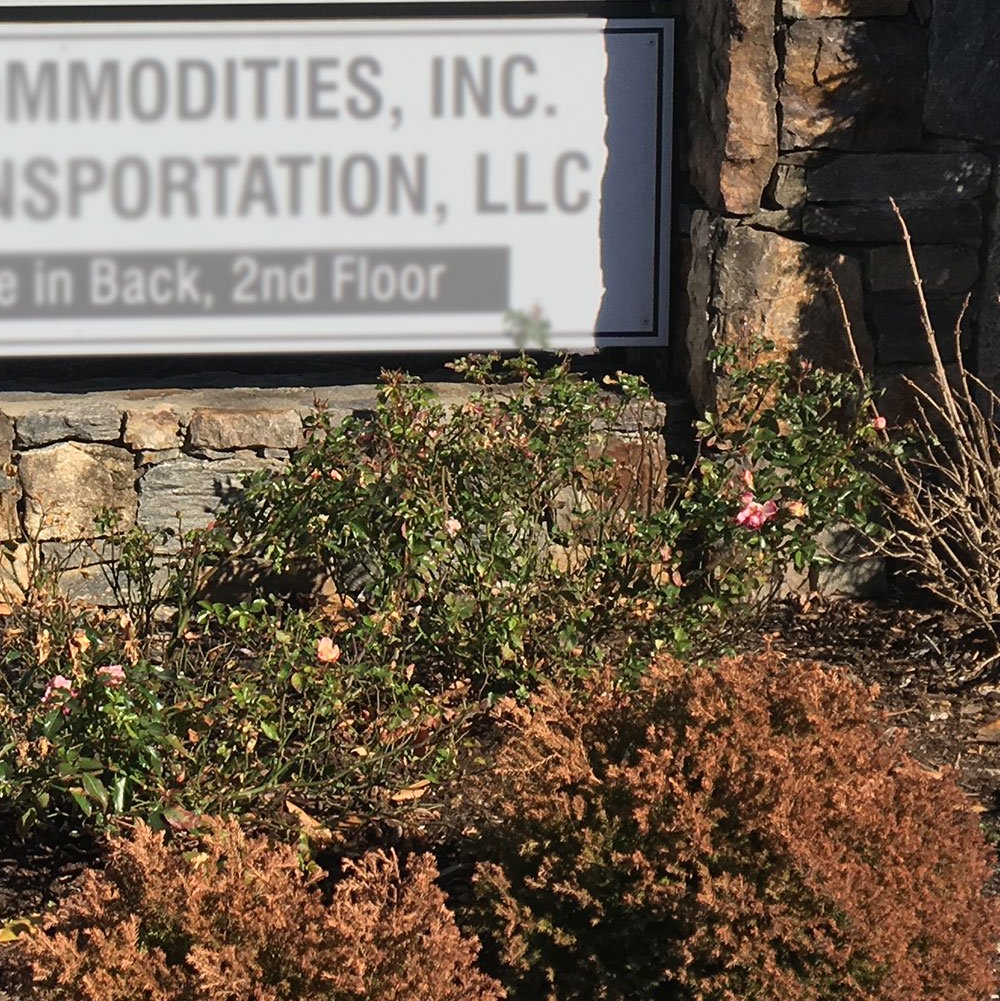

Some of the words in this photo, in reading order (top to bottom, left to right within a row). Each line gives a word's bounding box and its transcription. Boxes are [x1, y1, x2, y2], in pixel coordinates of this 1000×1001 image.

[430, 53, 558, 120] INC.
[474, 149, 591, 215] LLC
[33, 258, 74, 306] in
[89, 257, 214, 310] Back,
[231, 255, 317, 304] 2nd
[331, 254, 447, 303] Floor
